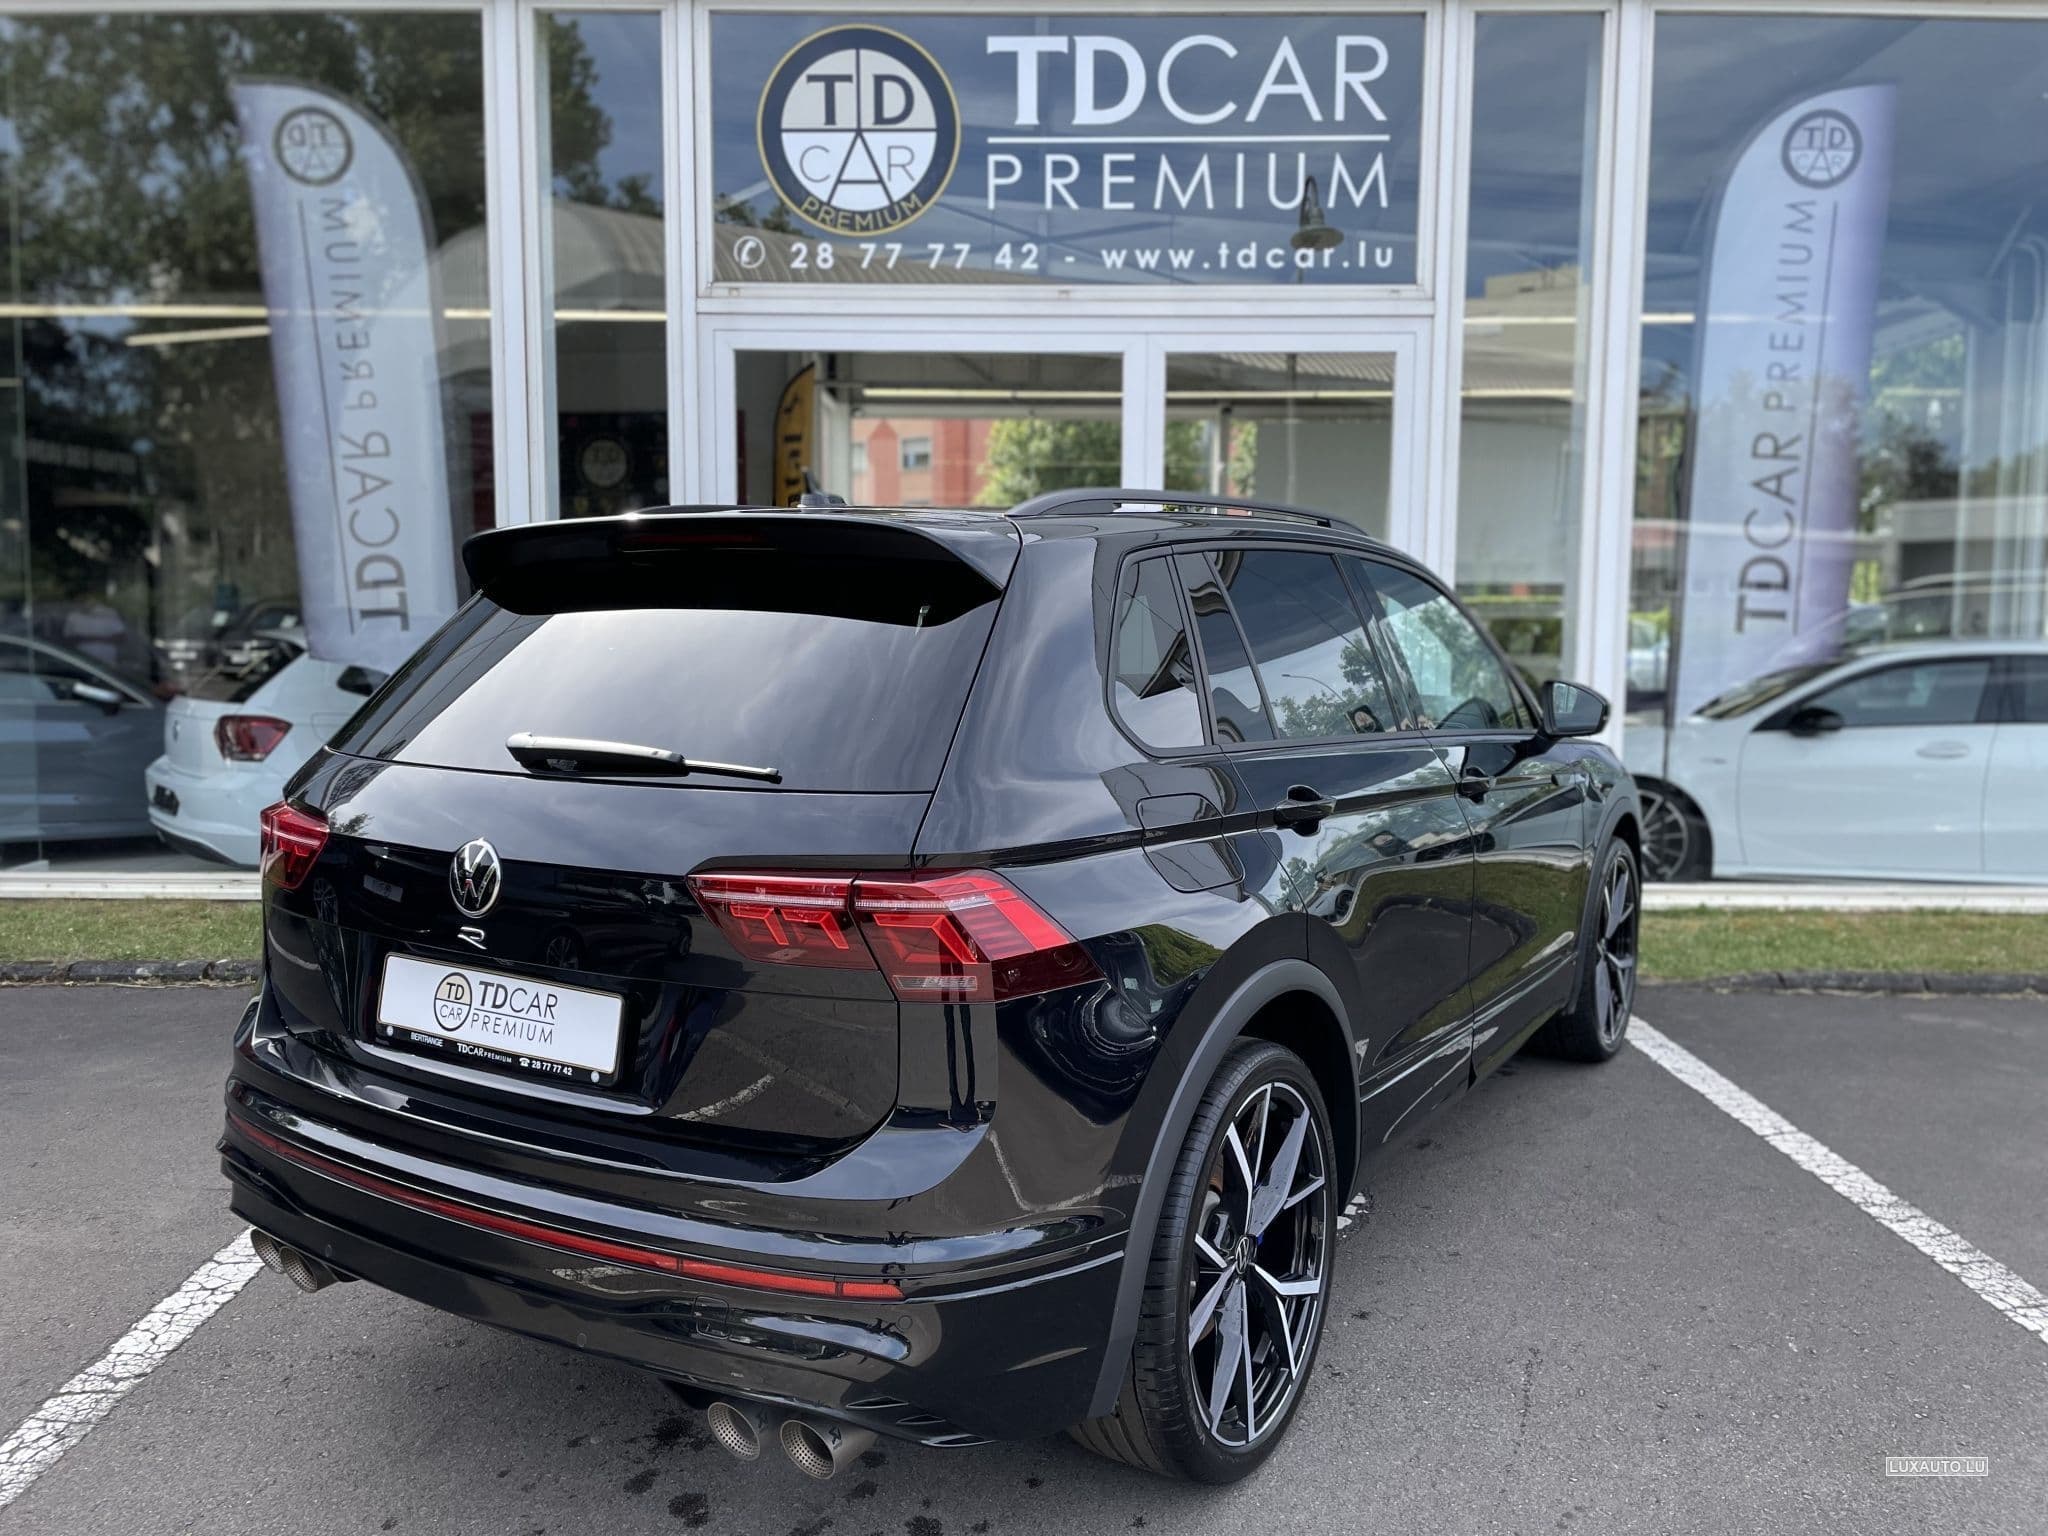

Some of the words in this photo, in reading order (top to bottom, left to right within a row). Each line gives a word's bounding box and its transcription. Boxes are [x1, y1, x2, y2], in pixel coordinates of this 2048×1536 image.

[986, 34, 1388, 126] TDCAR
[987, 152, 1389, 210] PREMIUM
[801, 193, 923, 232] PREMIUM
[789, 242, 835, 270] 28
[859, 242, 903, 270] 77
[927, 242, 971, 270] 77
[993, 242, 1039, 270] 42
[1100, 240, 1394, 270] www.tdcar.lu
[1763, 199, 1818, 413] PREMIUM
[1735, 431, 1803, 634] TDCAR
[446, 981, 465, 1001] TD
[478, 980, 558, 1020] TDCAR
[439, 1004, 463, 1020] CAR
[470, 1012, 554, 1045] PREMIUM
[531, 1059, 541, 1070] 28
[542, 1061, 552, 1072] 77
[552, 1064, 562, 1074] 77
[562, 1066, 573, 1076] 42
